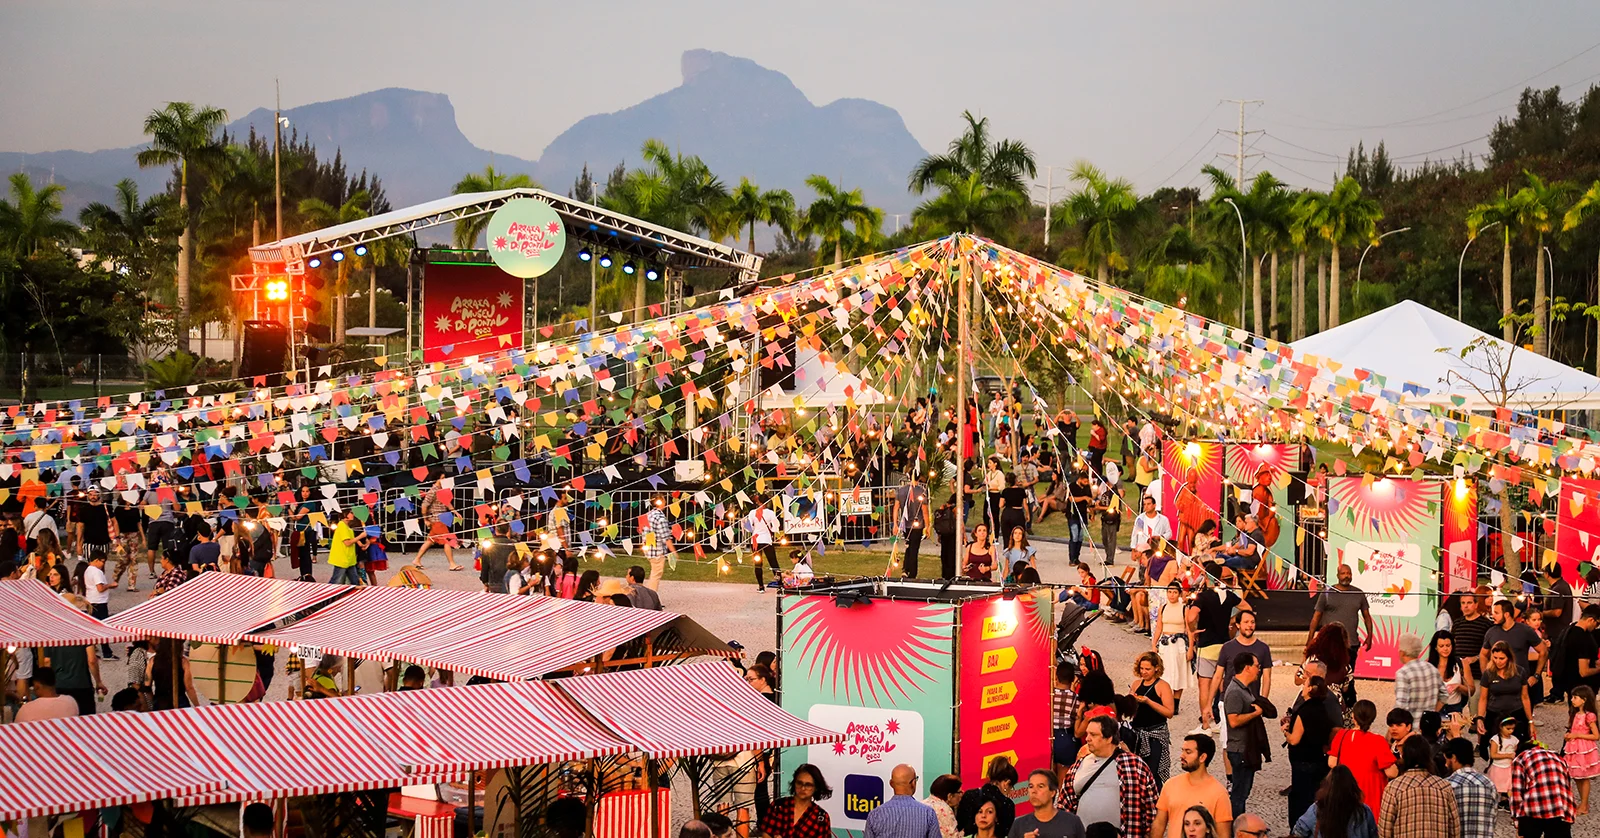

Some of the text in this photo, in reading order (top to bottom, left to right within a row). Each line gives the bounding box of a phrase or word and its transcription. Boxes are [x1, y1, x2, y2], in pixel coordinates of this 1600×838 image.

[461, 304, 496, 320] MUSEU
[468, 314, 509, 333] PONTAL
[1370, 597, 1395, 605] Sinopec
[987, 654, 999, 668] BAR
[855, 731, 885, 745] MUSEU
[860, 740, 896, 758] PONTAL
[847, 794, 881, 812] Itaú
